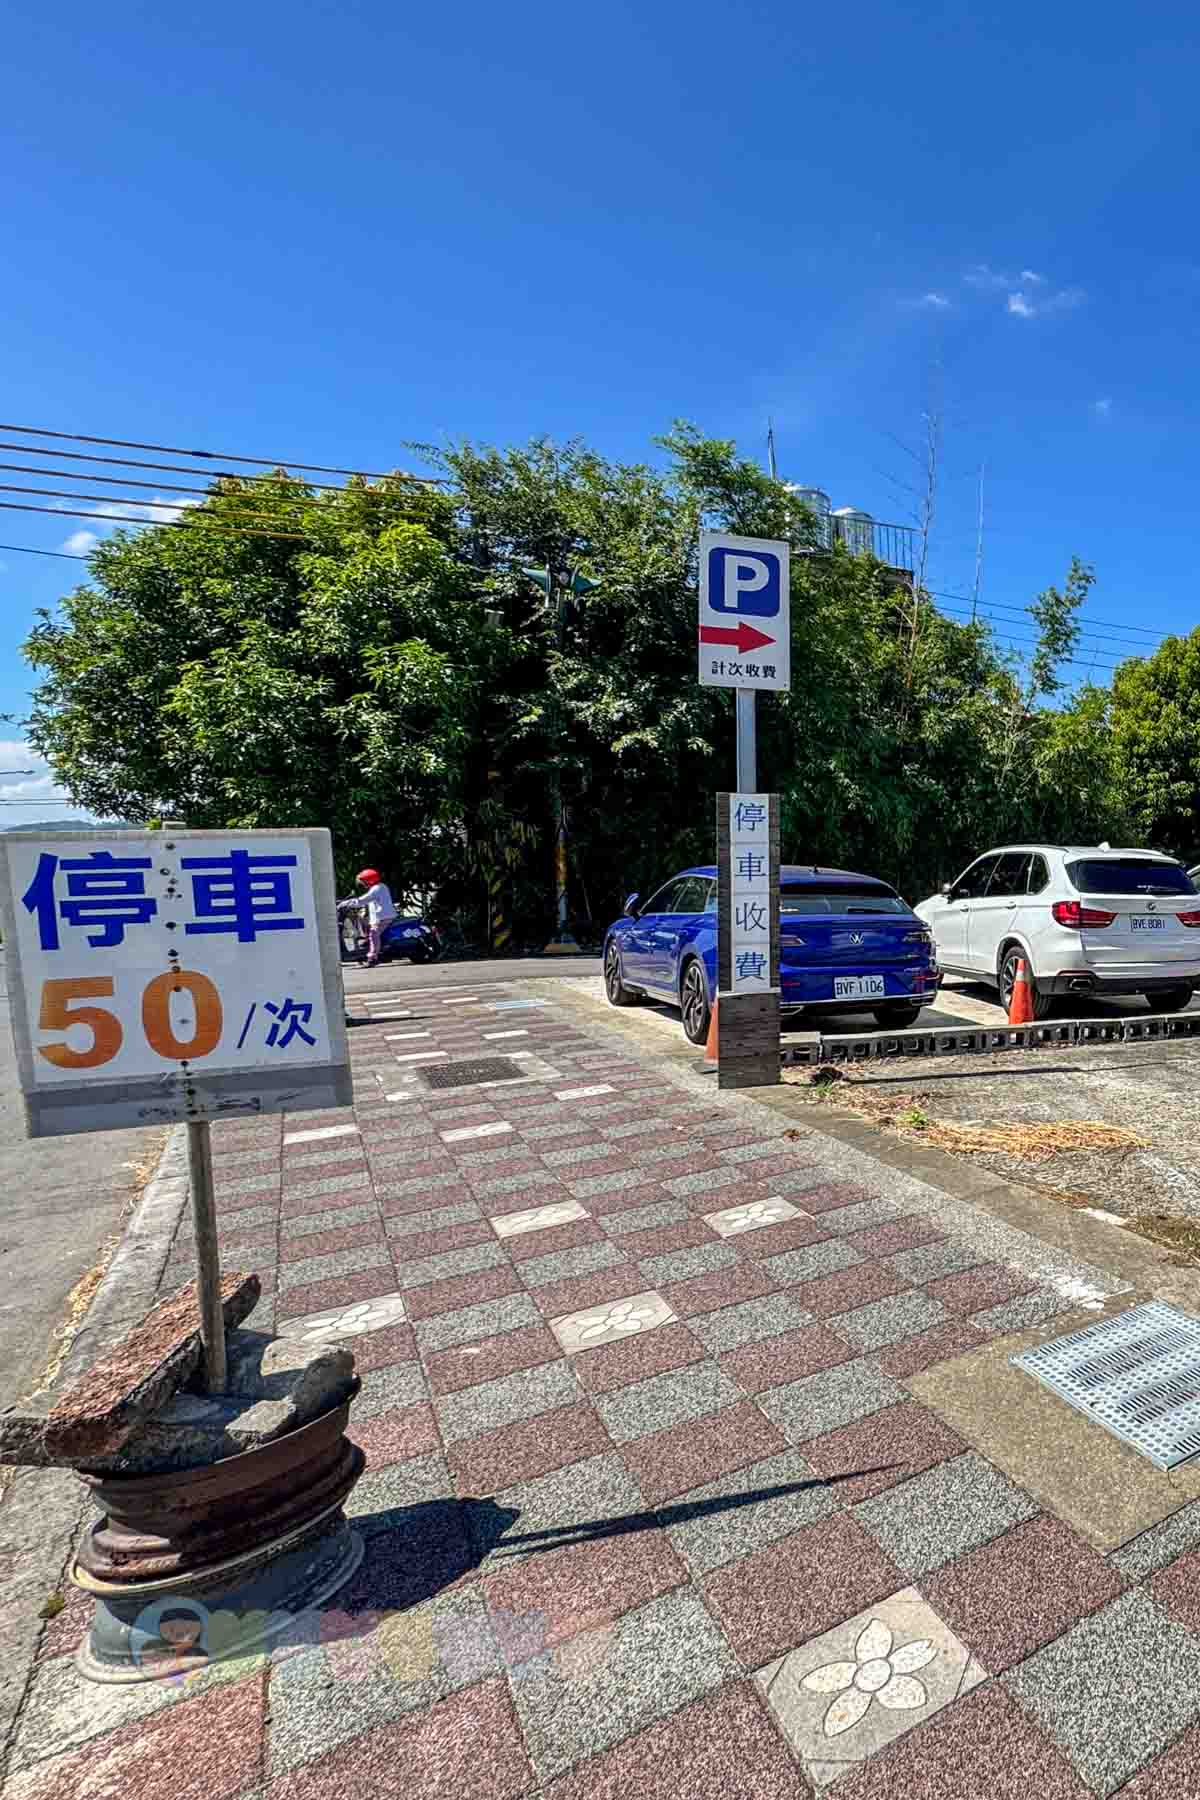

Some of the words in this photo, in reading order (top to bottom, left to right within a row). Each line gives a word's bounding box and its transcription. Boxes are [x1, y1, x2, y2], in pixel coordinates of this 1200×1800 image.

[724, 554, 770, 608] P
[711, 660, 776, 679] 計次收費
[22, 850, 304, 950] 停車
[734, 802, 767, 981] 停車收費
